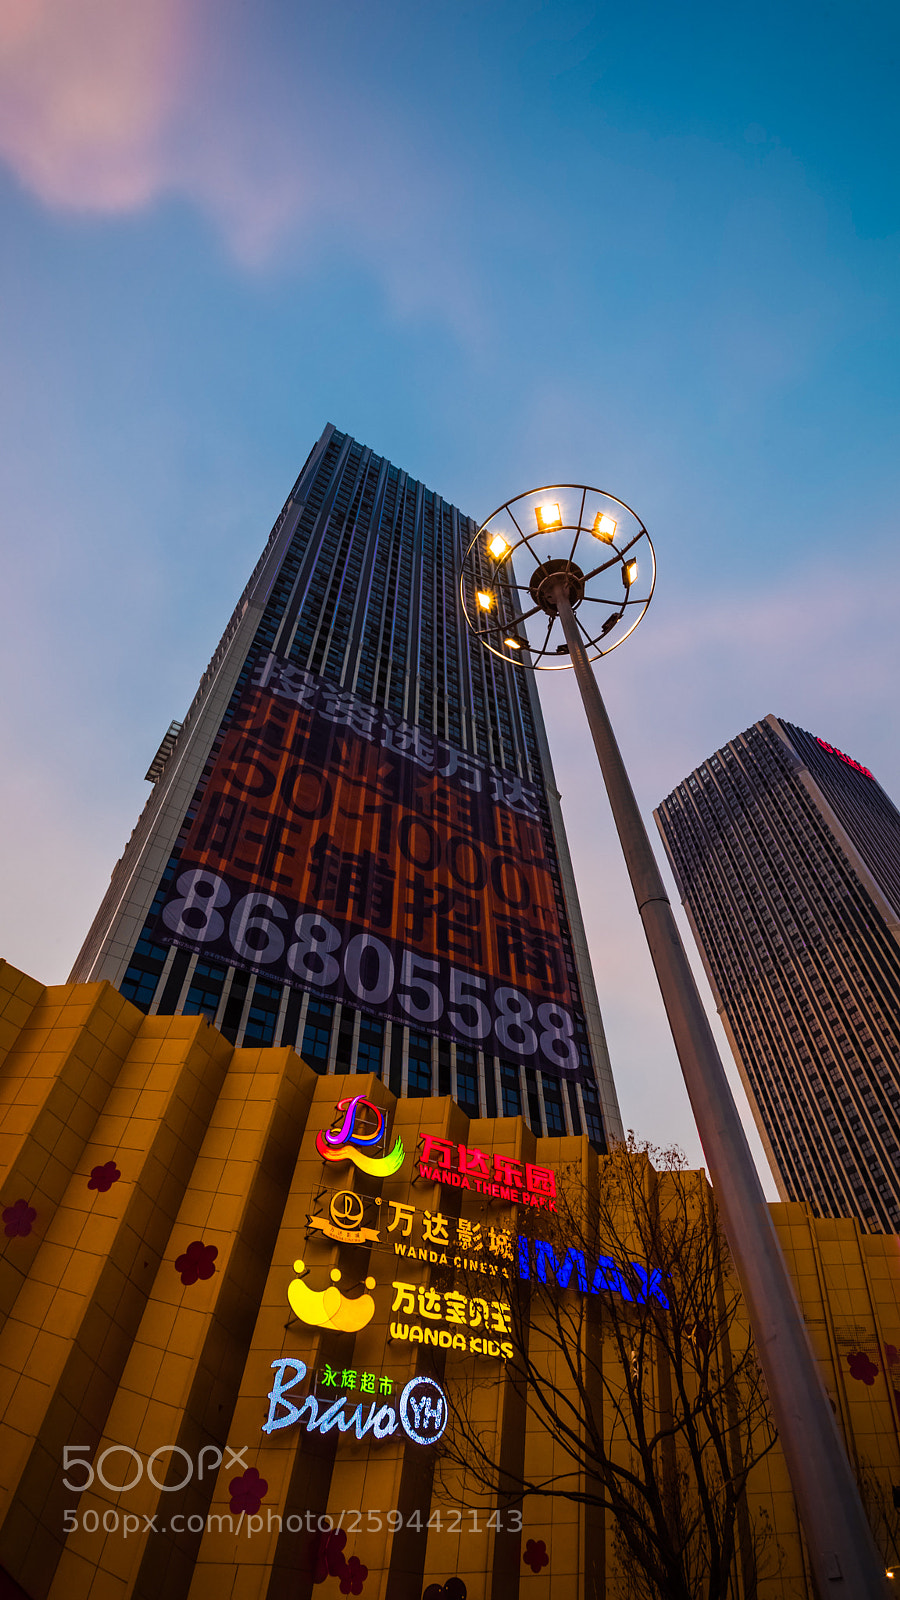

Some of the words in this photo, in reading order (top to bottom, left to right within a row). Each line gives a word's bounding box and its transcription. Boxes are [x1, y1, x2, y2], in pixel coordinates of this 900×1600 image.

[251, 652, 541, 821] 投资选万达
[162, 868, 581, 1070] 86805588
[419, 1132, 557, 1198] 万达乐园
[419, 1164, 471, 1190] WANDA
[474, 1180, 519, 1203] THEME
[522, 1192, 558, 1213] PARK
[387, 1200, 515, 1262] 万达影城
[394, 1242, 448, 1265] WANDA
[518, 1234, 671, 1310] IMAX
[391, 1281, 512, 1333] 万达宝贝王
[390, 1322, 467, 1352] WANDA
[469, 1336, 514, 1359] KIDS
[261, 1357, 399, 1440] Bravo
[409, 1396, 443, 1430] YH
[321, 1363, 394, 1396] 永辉超市
